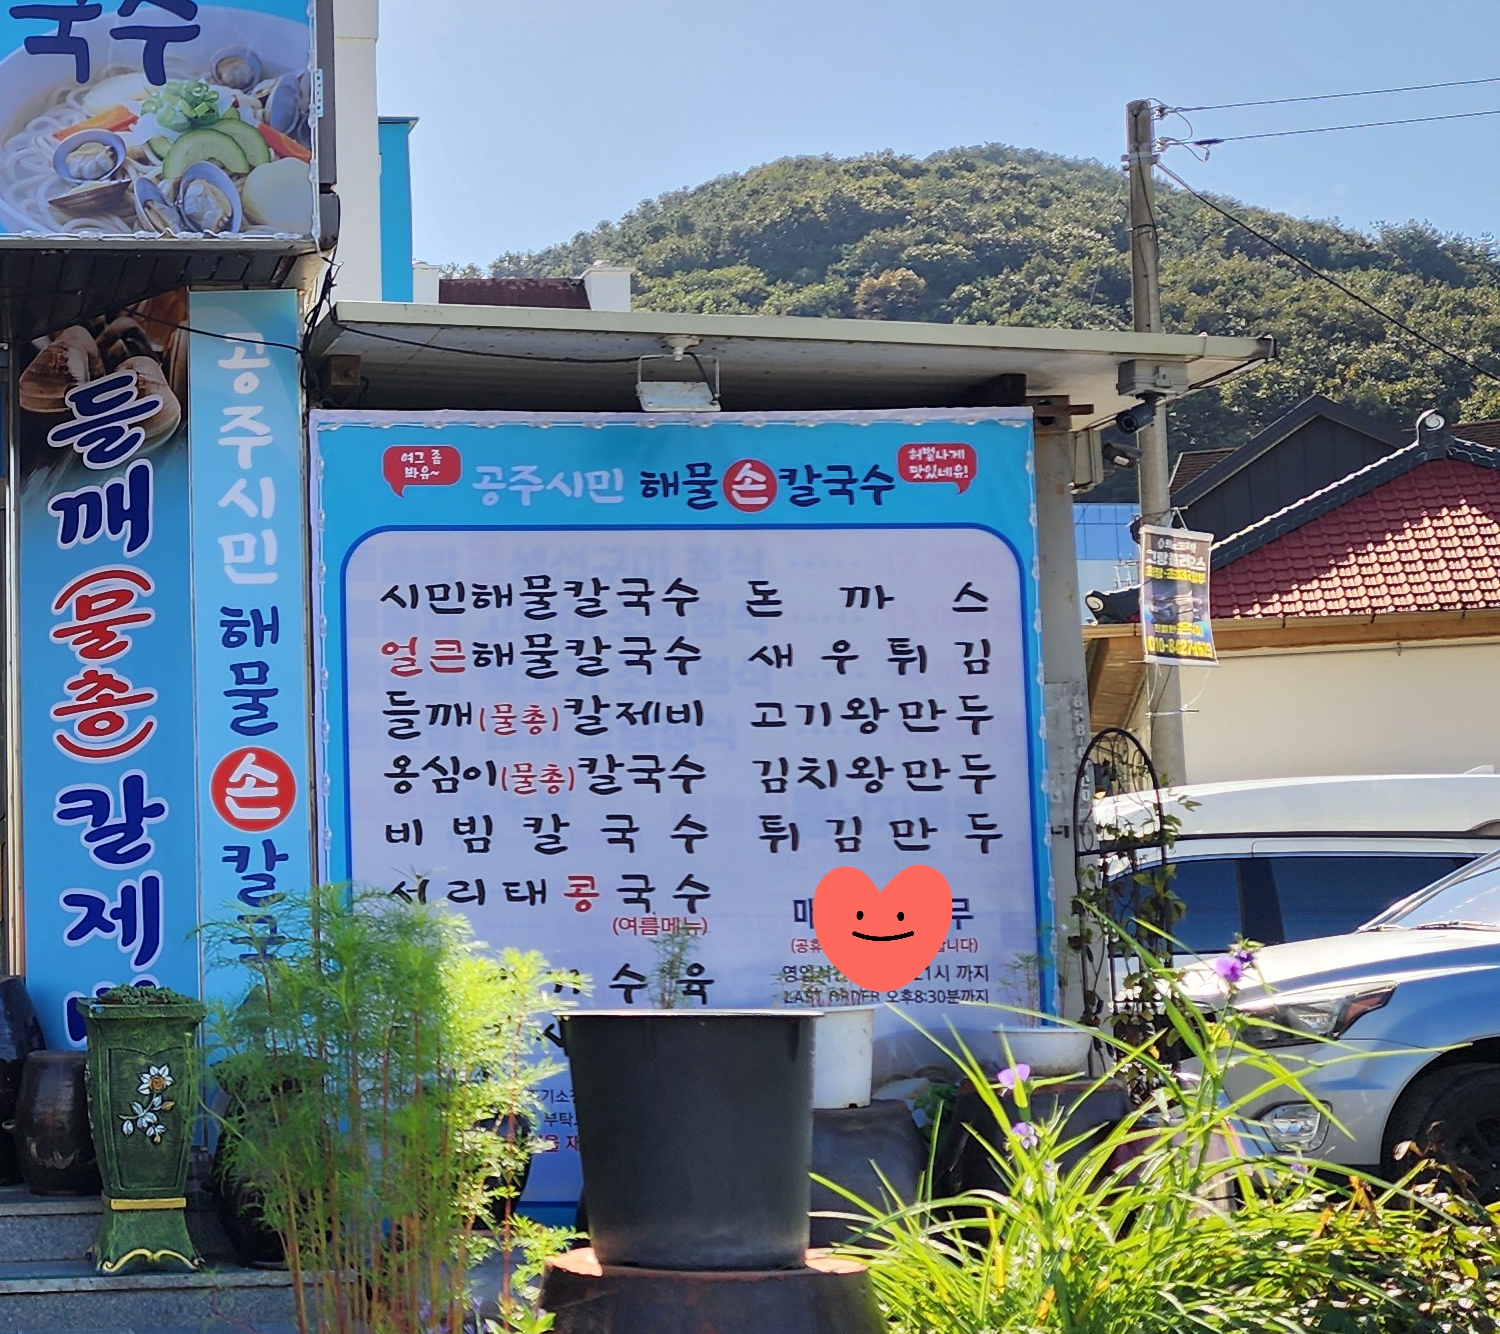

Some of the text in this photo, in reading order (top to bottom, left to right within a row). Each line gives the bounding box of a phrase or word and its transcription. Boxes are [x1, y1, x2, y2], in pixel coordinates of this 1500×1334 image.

[217, 332, 279, 584] 공주시민
[471, 465, 625, 507] 공주시민
[639, 462, 719, 511] 해물
[778, 463, 897, 508] 칼국수
[218, 604, 280, 737] 해물
[749, 694, 995, 735] 고기왕만두
[223, 751, 282, 820] 손
[751, 753, 997, 795] 김치왕만두
[611, 916, 709, 937] (여름메뉴)
[956, 964, 990, 983] 까지
